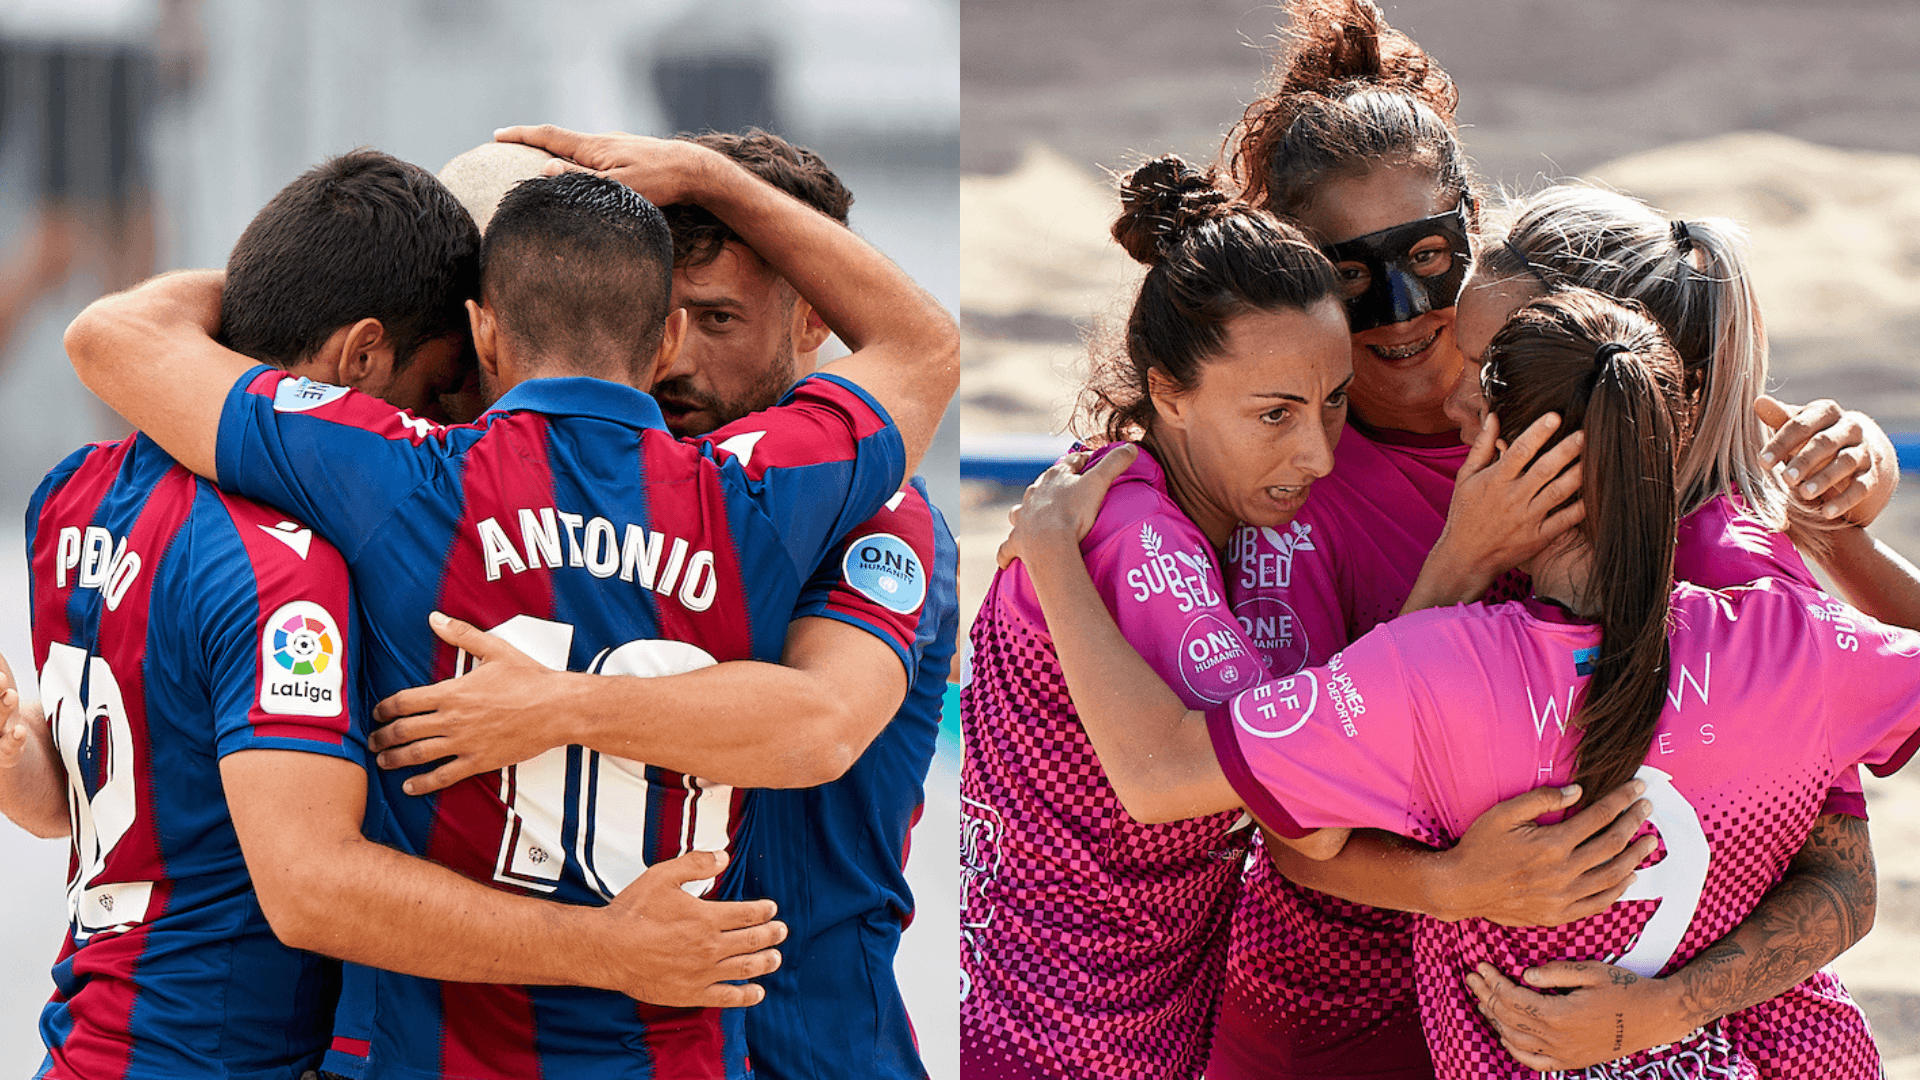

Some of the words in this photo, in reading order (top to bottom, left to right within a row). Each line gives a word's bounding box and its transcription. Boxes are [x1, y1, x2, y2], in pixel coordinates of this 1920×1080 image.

[476, 506, 718, 612] ANTONIO
[860, 546, 915, 579] ONE
[1188, 630, 1240, 662] ONE
[270, 680, 332, 703] LaLiga
[1326, 681, 1358, 738] DEPORTES
[1331, 672, 1366, 718] JAVIER
